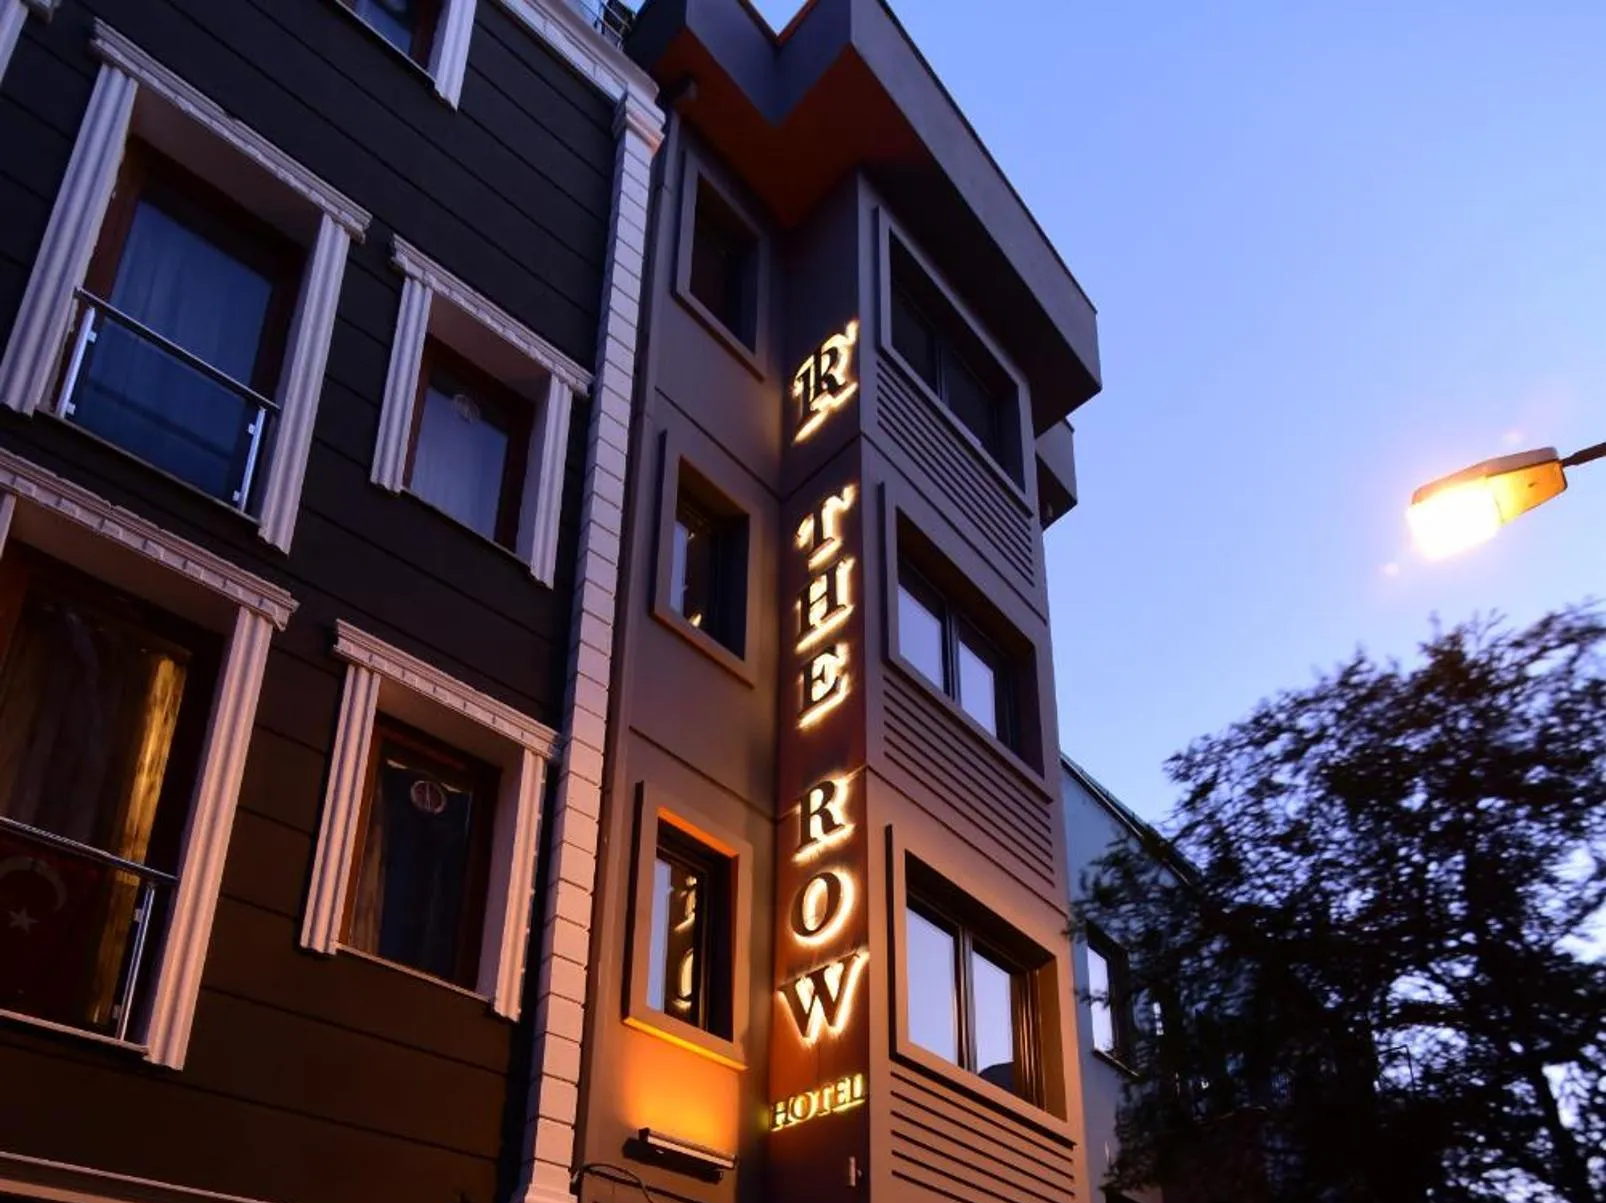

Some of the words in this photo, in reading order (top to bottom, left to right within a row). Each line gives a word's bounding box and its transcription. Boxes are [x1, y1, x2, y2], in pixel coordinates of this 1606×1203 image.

[793, 483, 858, 730] THE
[777, 775, 869, 1048] ROW
[768, 1072, 866, 1132] HOTEL
